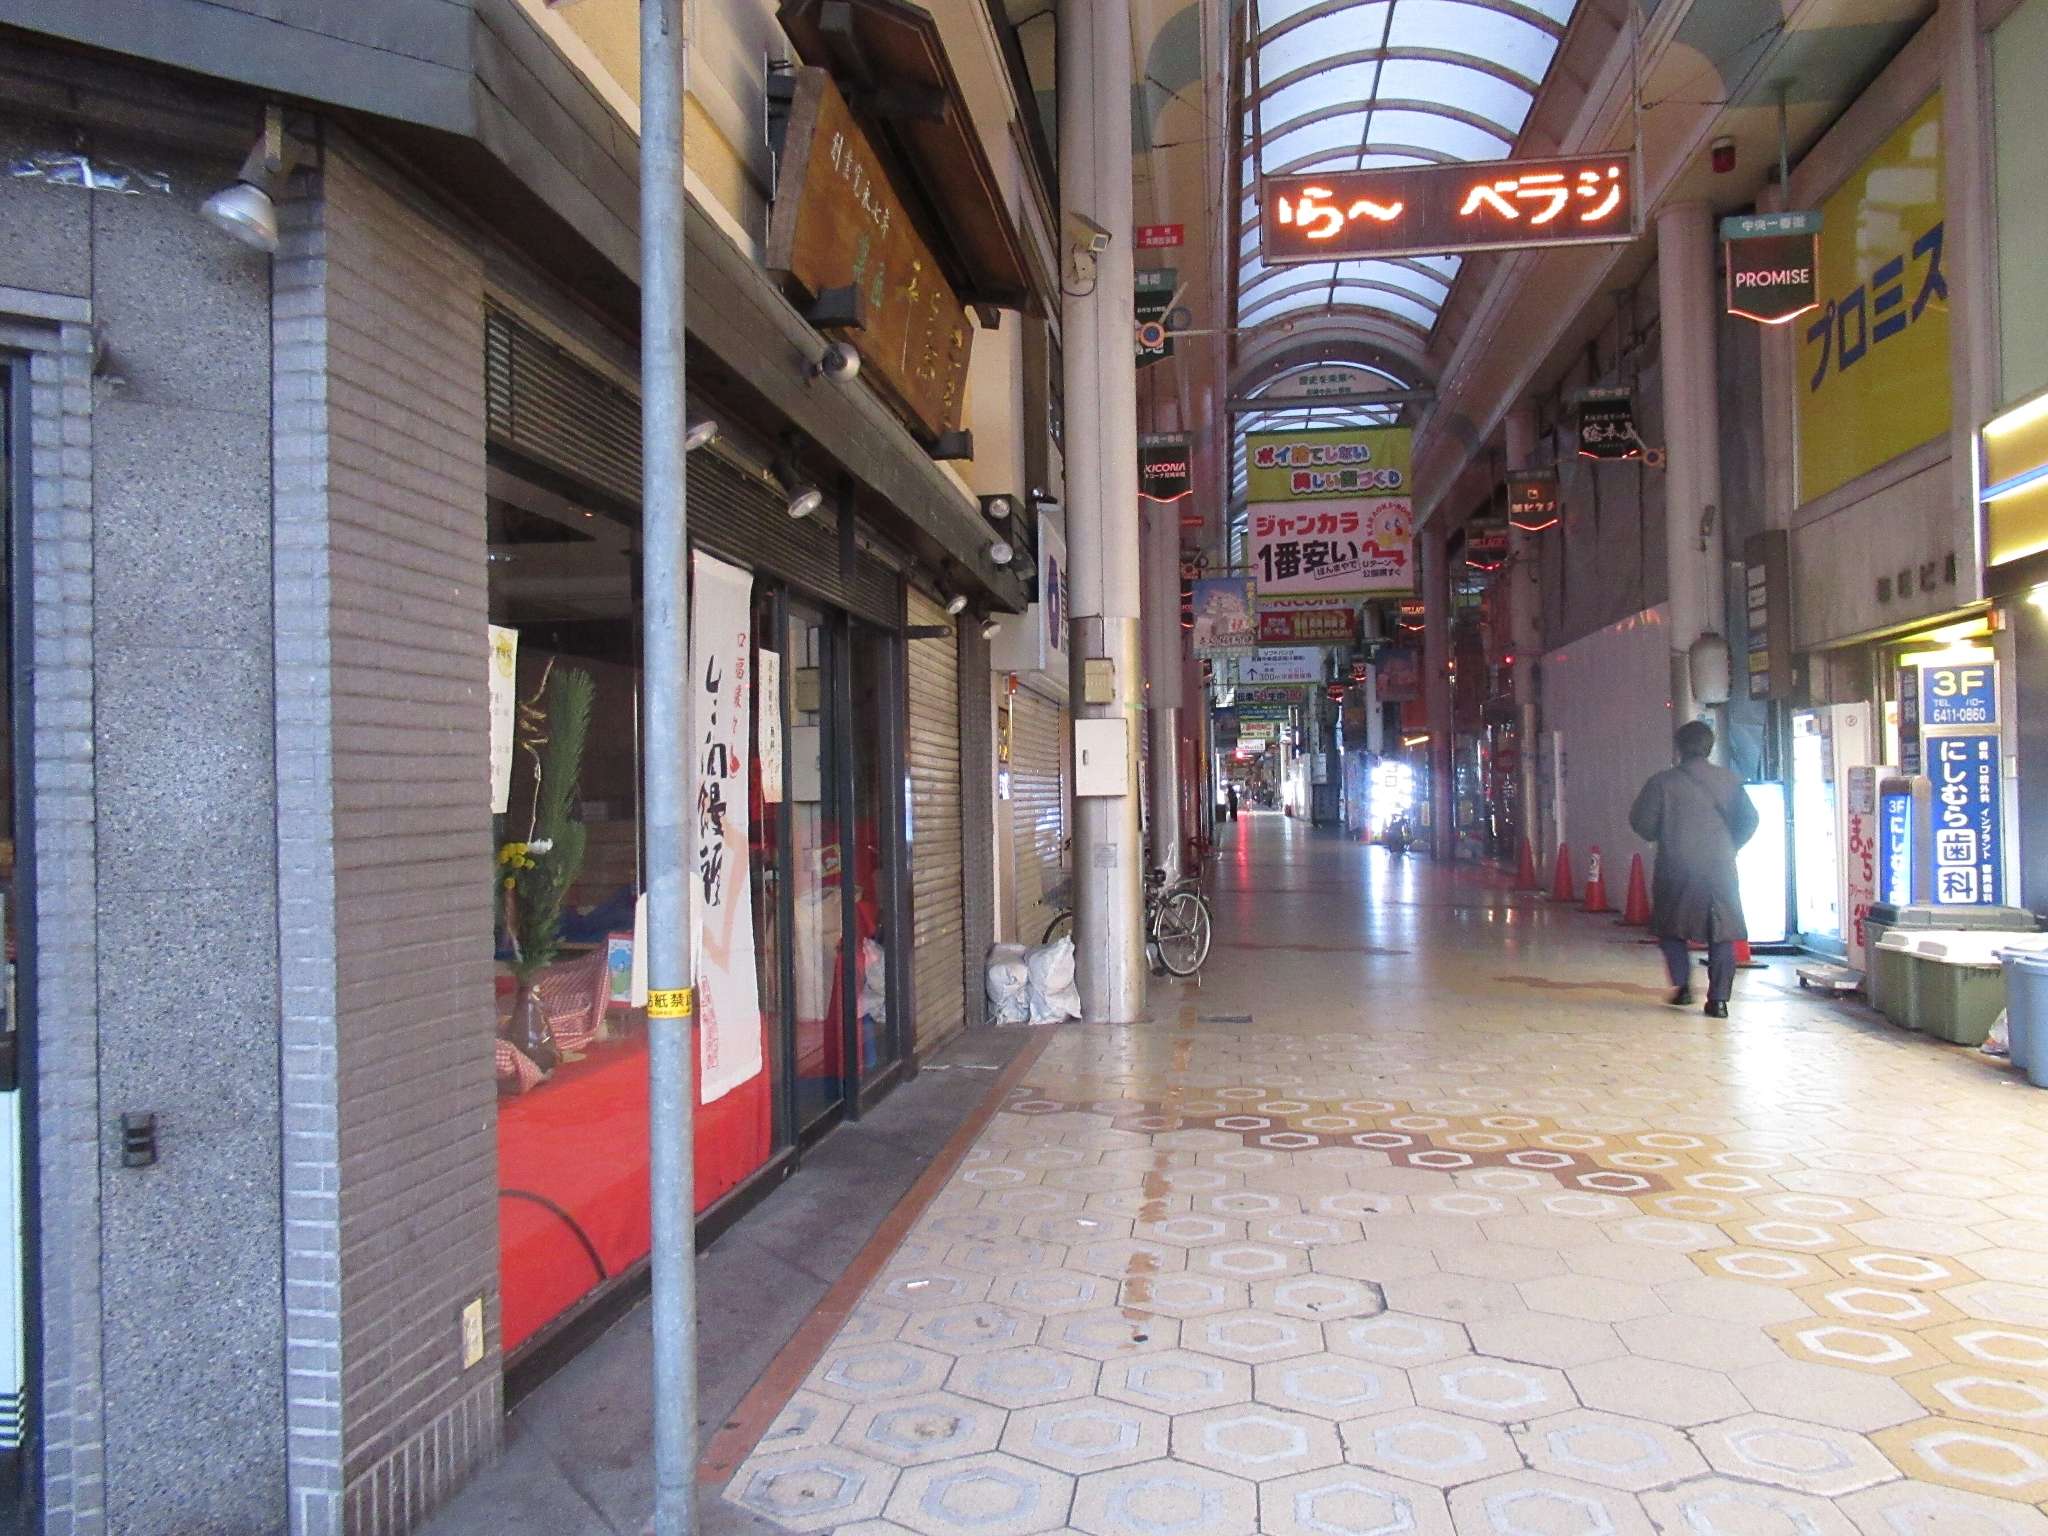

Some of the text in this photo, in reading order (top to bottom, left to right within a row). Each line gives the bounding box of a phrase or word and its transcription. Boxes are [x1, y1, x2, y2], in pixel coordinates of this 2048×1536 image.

[1459, 166, 1621, 225] ベラジ
[1736, 268, 1809, 288] PROMISE
[1807, 222, 1948, 392] プロミス
[1144, 462, 1186, 473] KICONA
[1256, 511, 1360, 537] ジャンカラ
[1258, 540, 1358, 582] 1番安い
[1933, 670, 1985, 697] 3F
[1934, 698, 1951, 708] TEL
[1941, 741, 1968, 828] にしむら
[1888, 800, 1905, 813] 3F
[1942, 833, 1974, 899] 歯科
